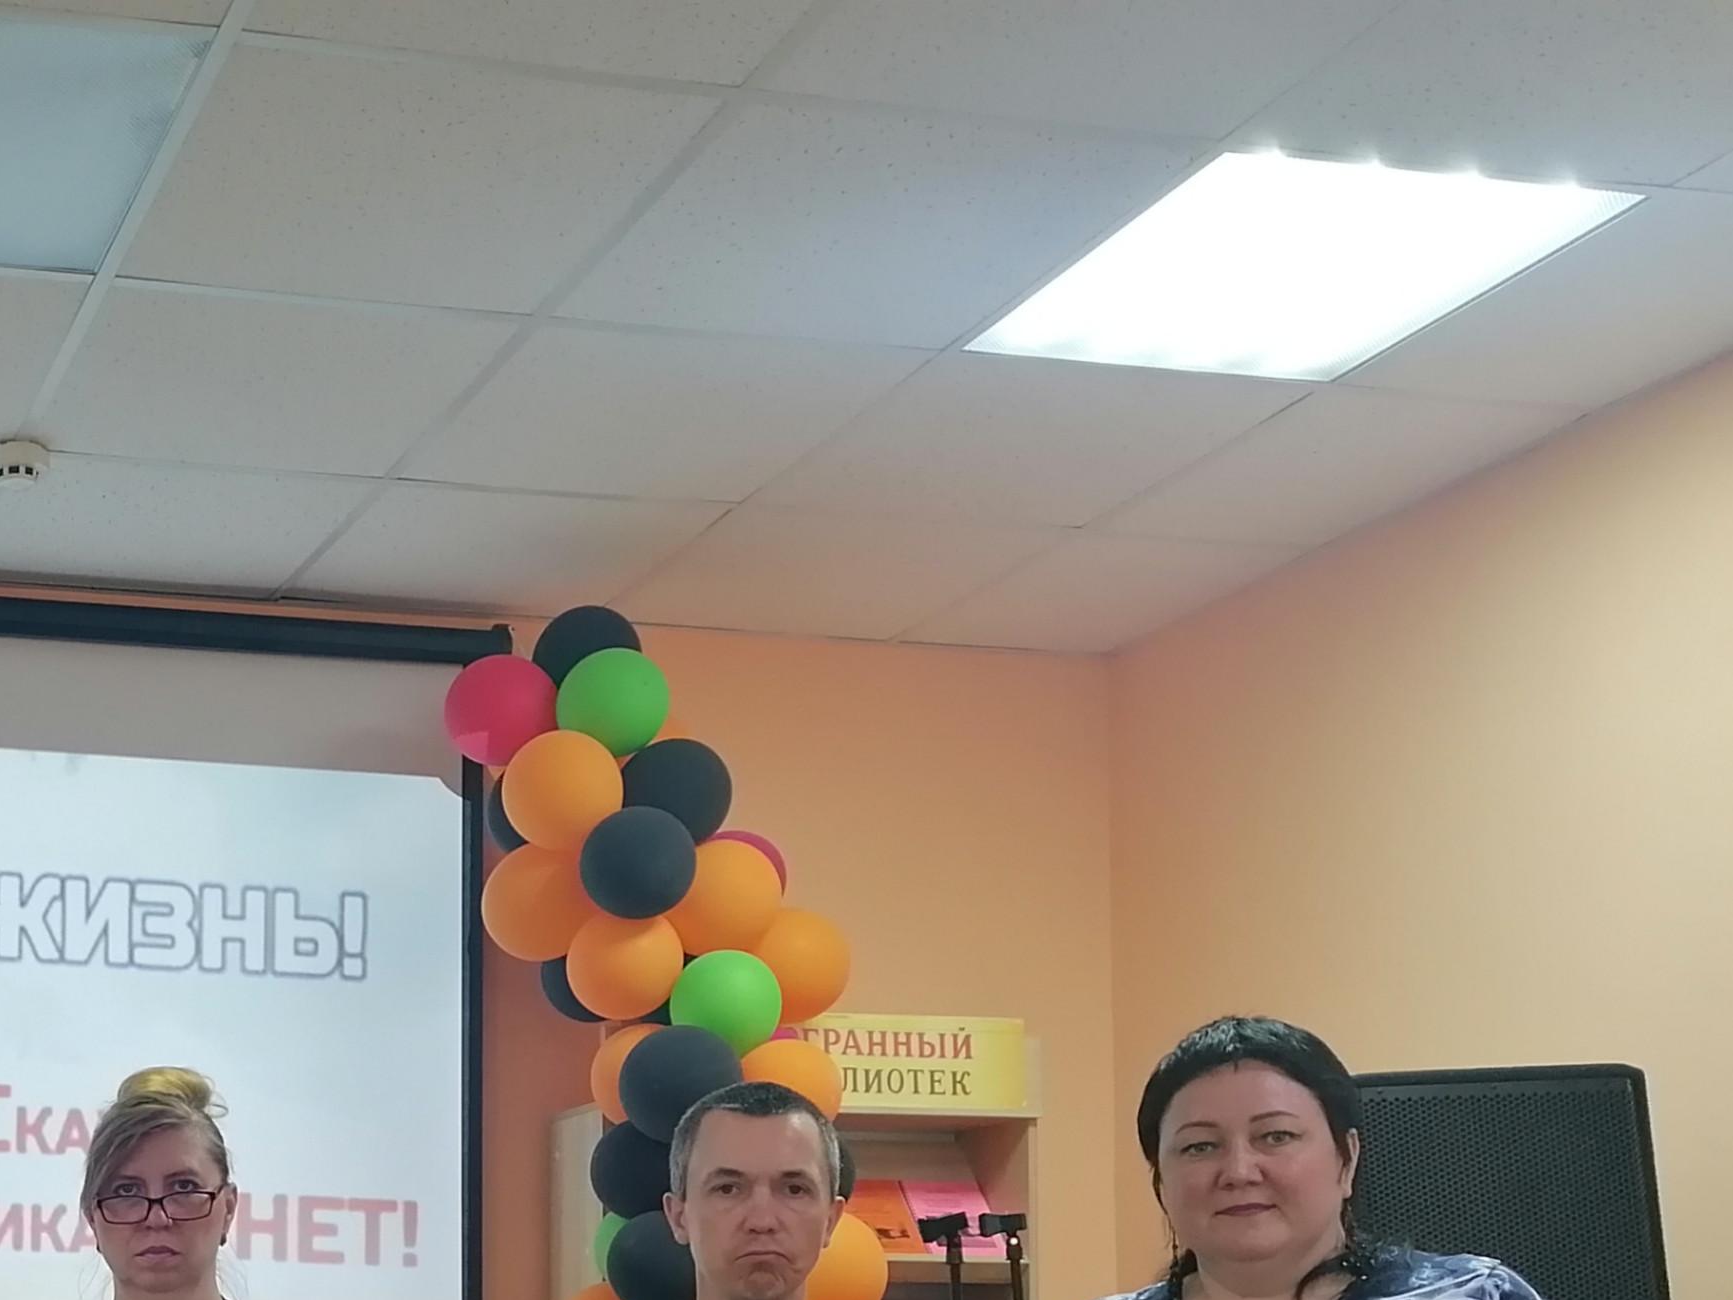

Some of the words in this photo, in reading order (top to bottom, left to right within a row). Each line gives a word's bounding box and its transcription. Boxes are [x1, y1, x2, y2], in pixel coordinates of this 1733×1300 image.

[801, 1027, 973, 1059] ГРАННЫЙ
[842, 1067, 972, 1097] ЛИОТЕК
[236, 1193, 418, 1267] НЕТ!
